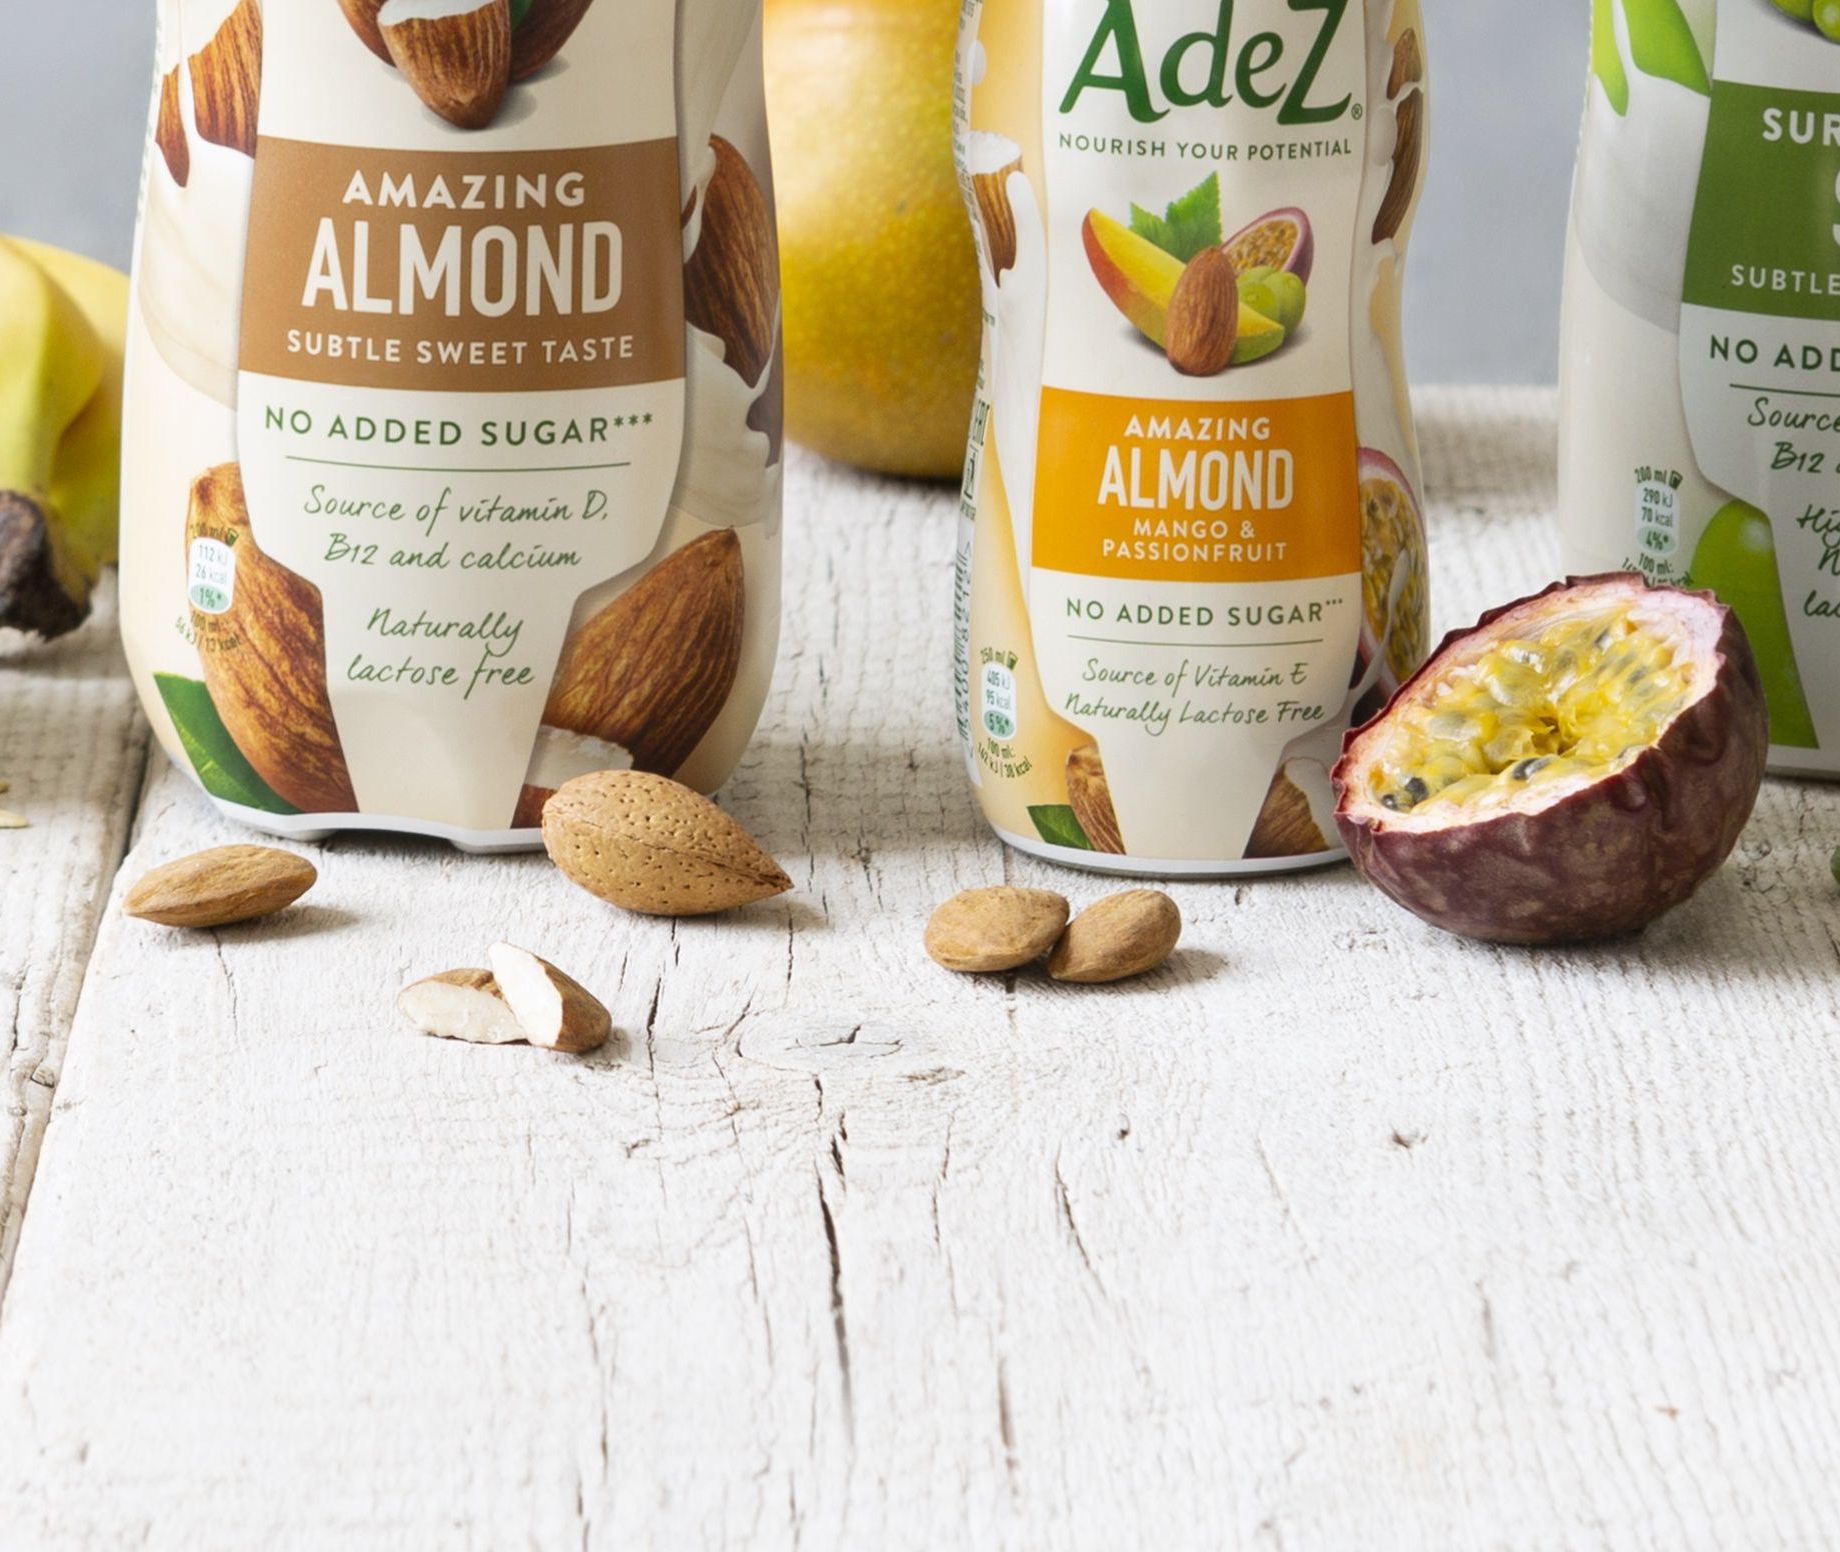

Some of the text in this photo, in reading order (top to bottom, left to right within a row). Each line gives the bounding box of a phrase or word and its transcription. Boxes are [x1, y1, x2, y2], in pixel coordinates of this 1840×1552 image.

[1059, 132, 1352, 161] NOURISH YOUR POTENTIAL
[342, 169, 585, 210] AMAZING
[301, 216, 623, 318] ALMOND
[287, 328, 634, 366] SUBTLE SWEET TASTE
[1709, 334, 1759, 364] NO
[264, 406, 313, 435] NO
[328, 415, 462, 446] ADDED
[1123, 414, 1271, 440] AMAZING
[1097, 444, 1293, 511] ALMOND
[1771, 442, 1825, 475] B12
[304, 484, 406, 521] Source
[415, 486, 453, 538] of
[459, 497, 572, 523] vitamin
[1133, 517, 1255, 539] MANGO &
[324, 532, 582, 571] B12 and calcium
[1102, 540, 1287, 563] PASSIONFRUIT
[1066, 597, 1104, 621] NO
[1116, 603, 1213, 626] ADDED
[366, 607, 524, 658] Naturally
[346, 641, 536, 701] lactose free
[1082, 658, 1308, 699] Source of Vitamin E
[1064, 693, 1325, 737] Naturally Lactose Free
